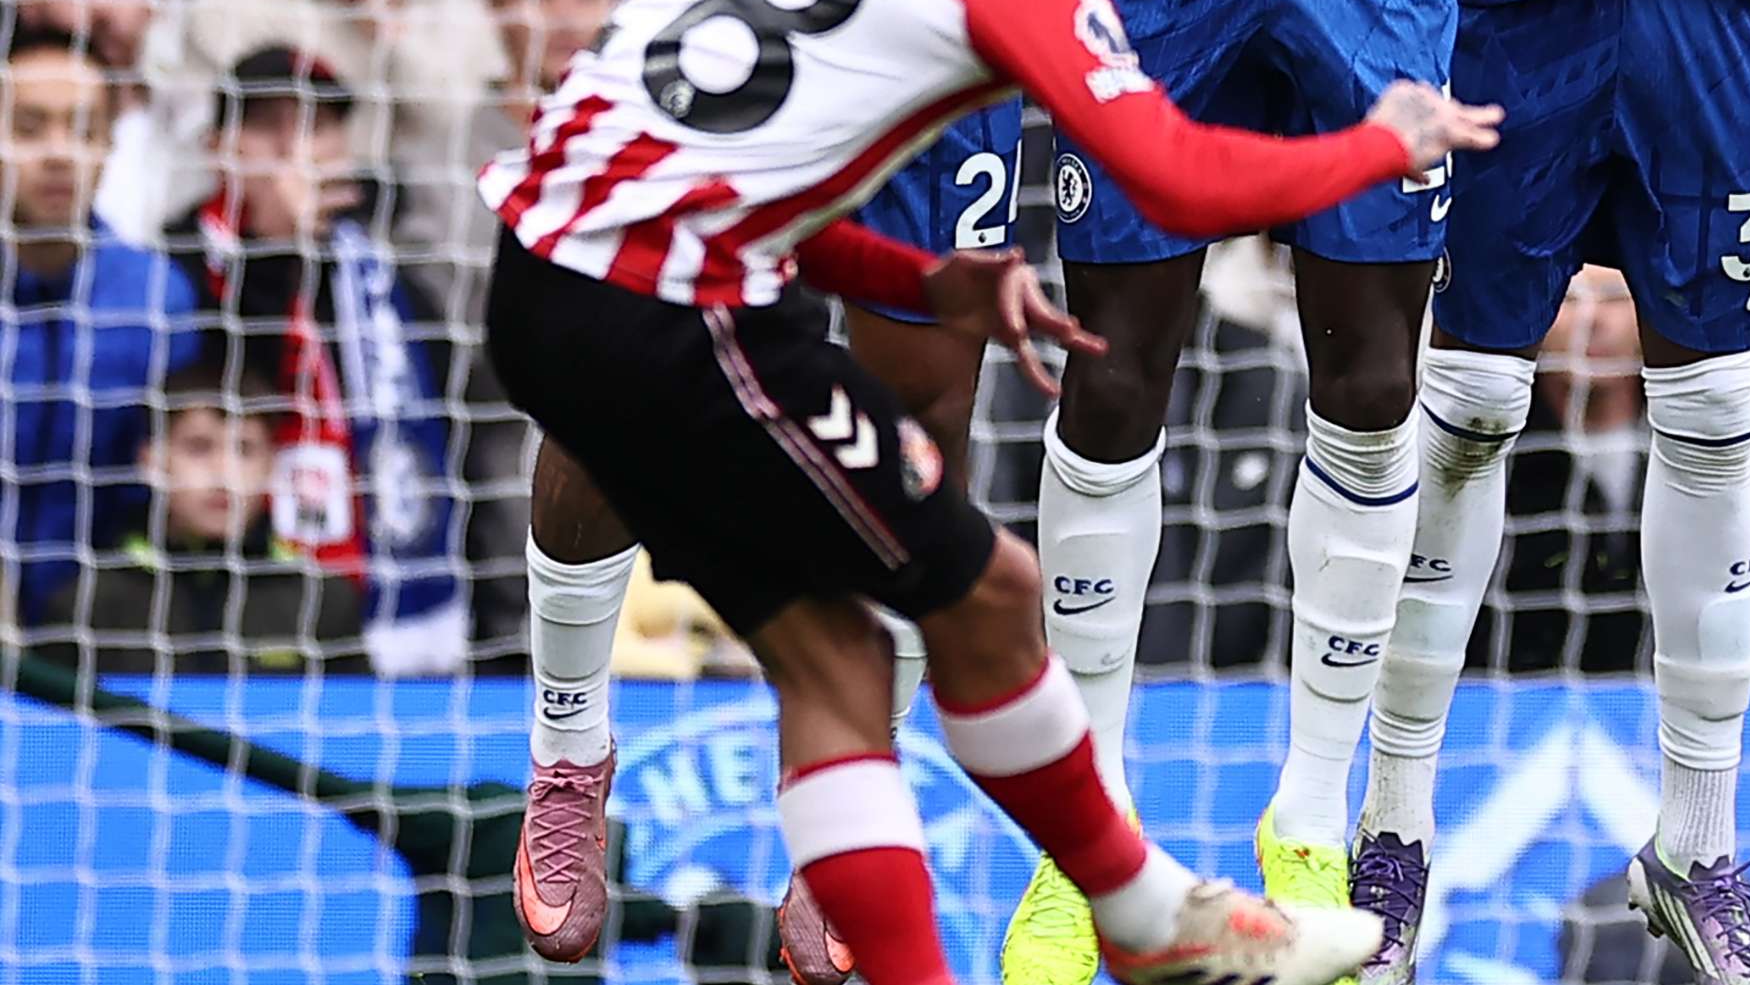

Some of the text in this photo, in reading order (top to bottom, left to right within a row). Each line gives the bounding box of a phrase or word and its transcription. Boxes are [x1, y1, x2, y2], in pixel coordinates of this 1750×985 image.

[955, 139, 1022, 249] 2
[1409, 553, 1452, 572] FC
[1054, 576, 1115, 596] CFC
[1327, 635, 1380, 657] CFC
[543, 689, 588, 706] CFC
